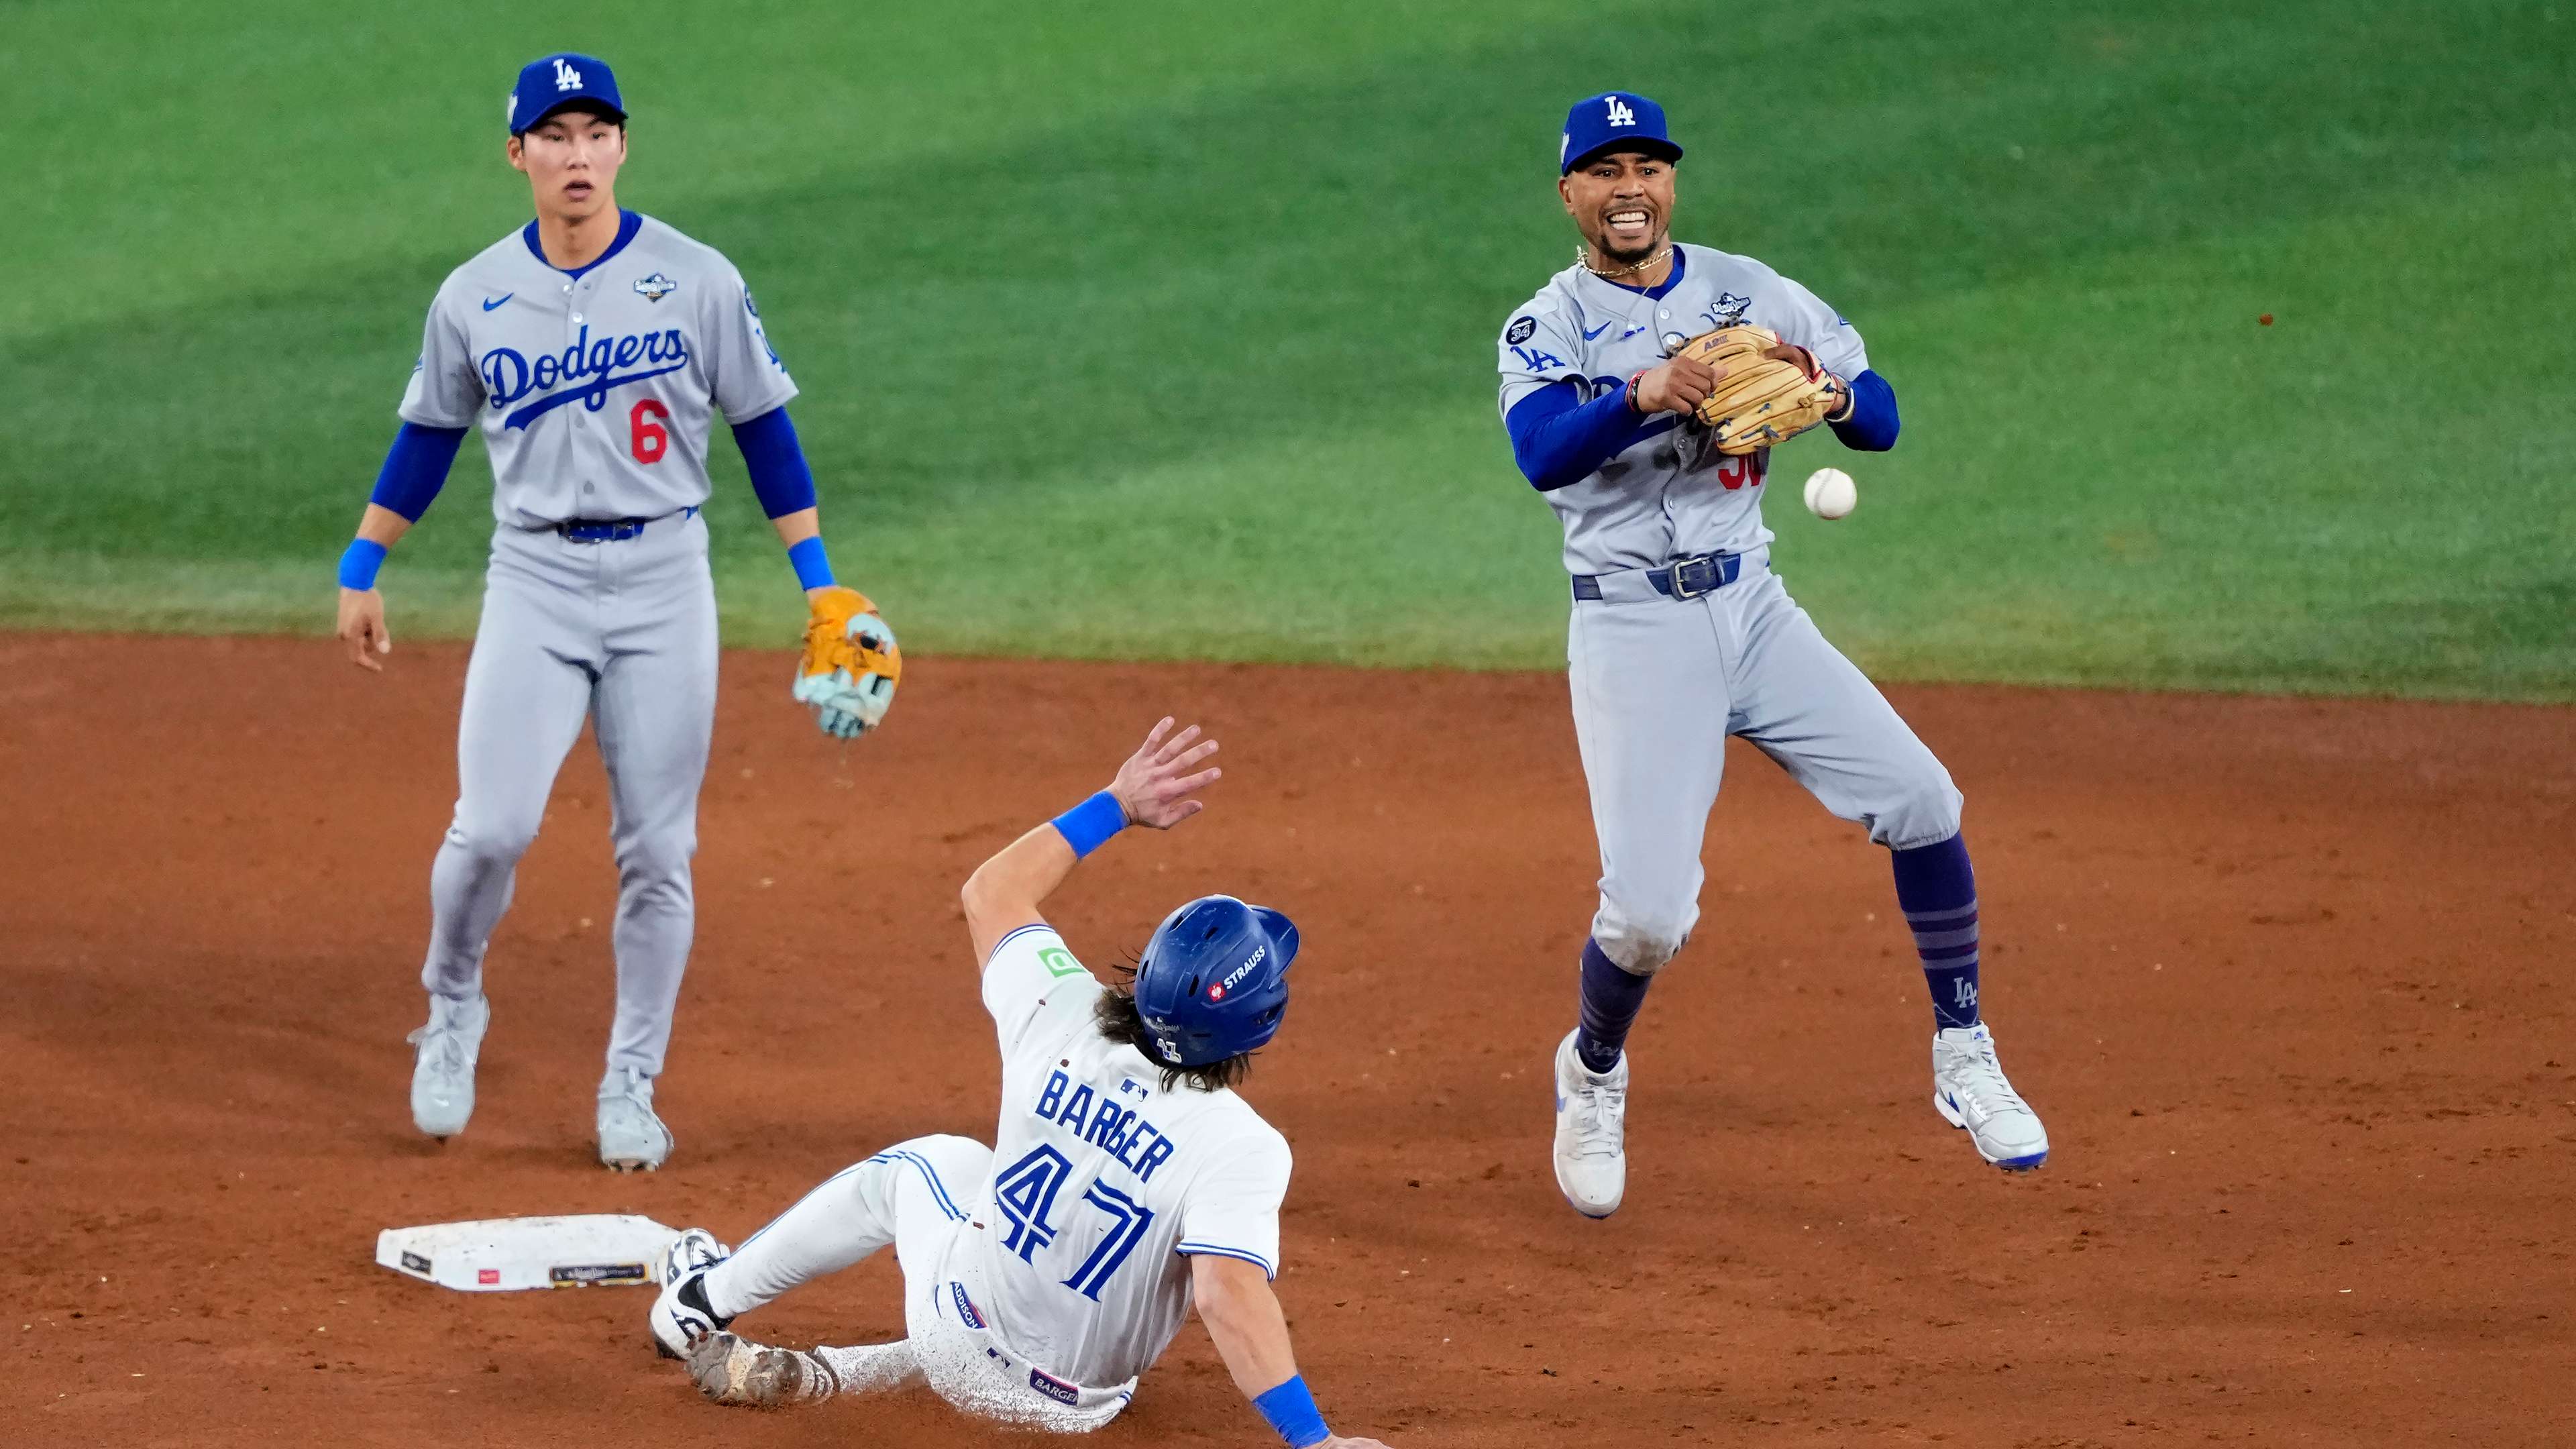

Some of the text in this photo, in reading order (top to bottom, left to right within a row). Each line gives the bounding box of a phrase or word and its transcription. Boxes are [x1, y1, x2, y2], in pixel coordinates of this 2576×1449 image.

[553, 58, 583, 91] LA
[1605, 96, 1635, 127] LA
[1511, 325, 1530, 341] 34
[482, 325, 688, 412] Dodgers
[1510, 345, 1566, 372] LA
[631, 398, 669, 464] 6
[1224, 945, 1266, 989] STRAUSS
[1953, 977, 1978, 1008] LA
[1035, 1069, 1174, 1184] BARGER
[996, 1142, 1156, 1303] 47
[954, 1283, 978, 1329] ADDISON
